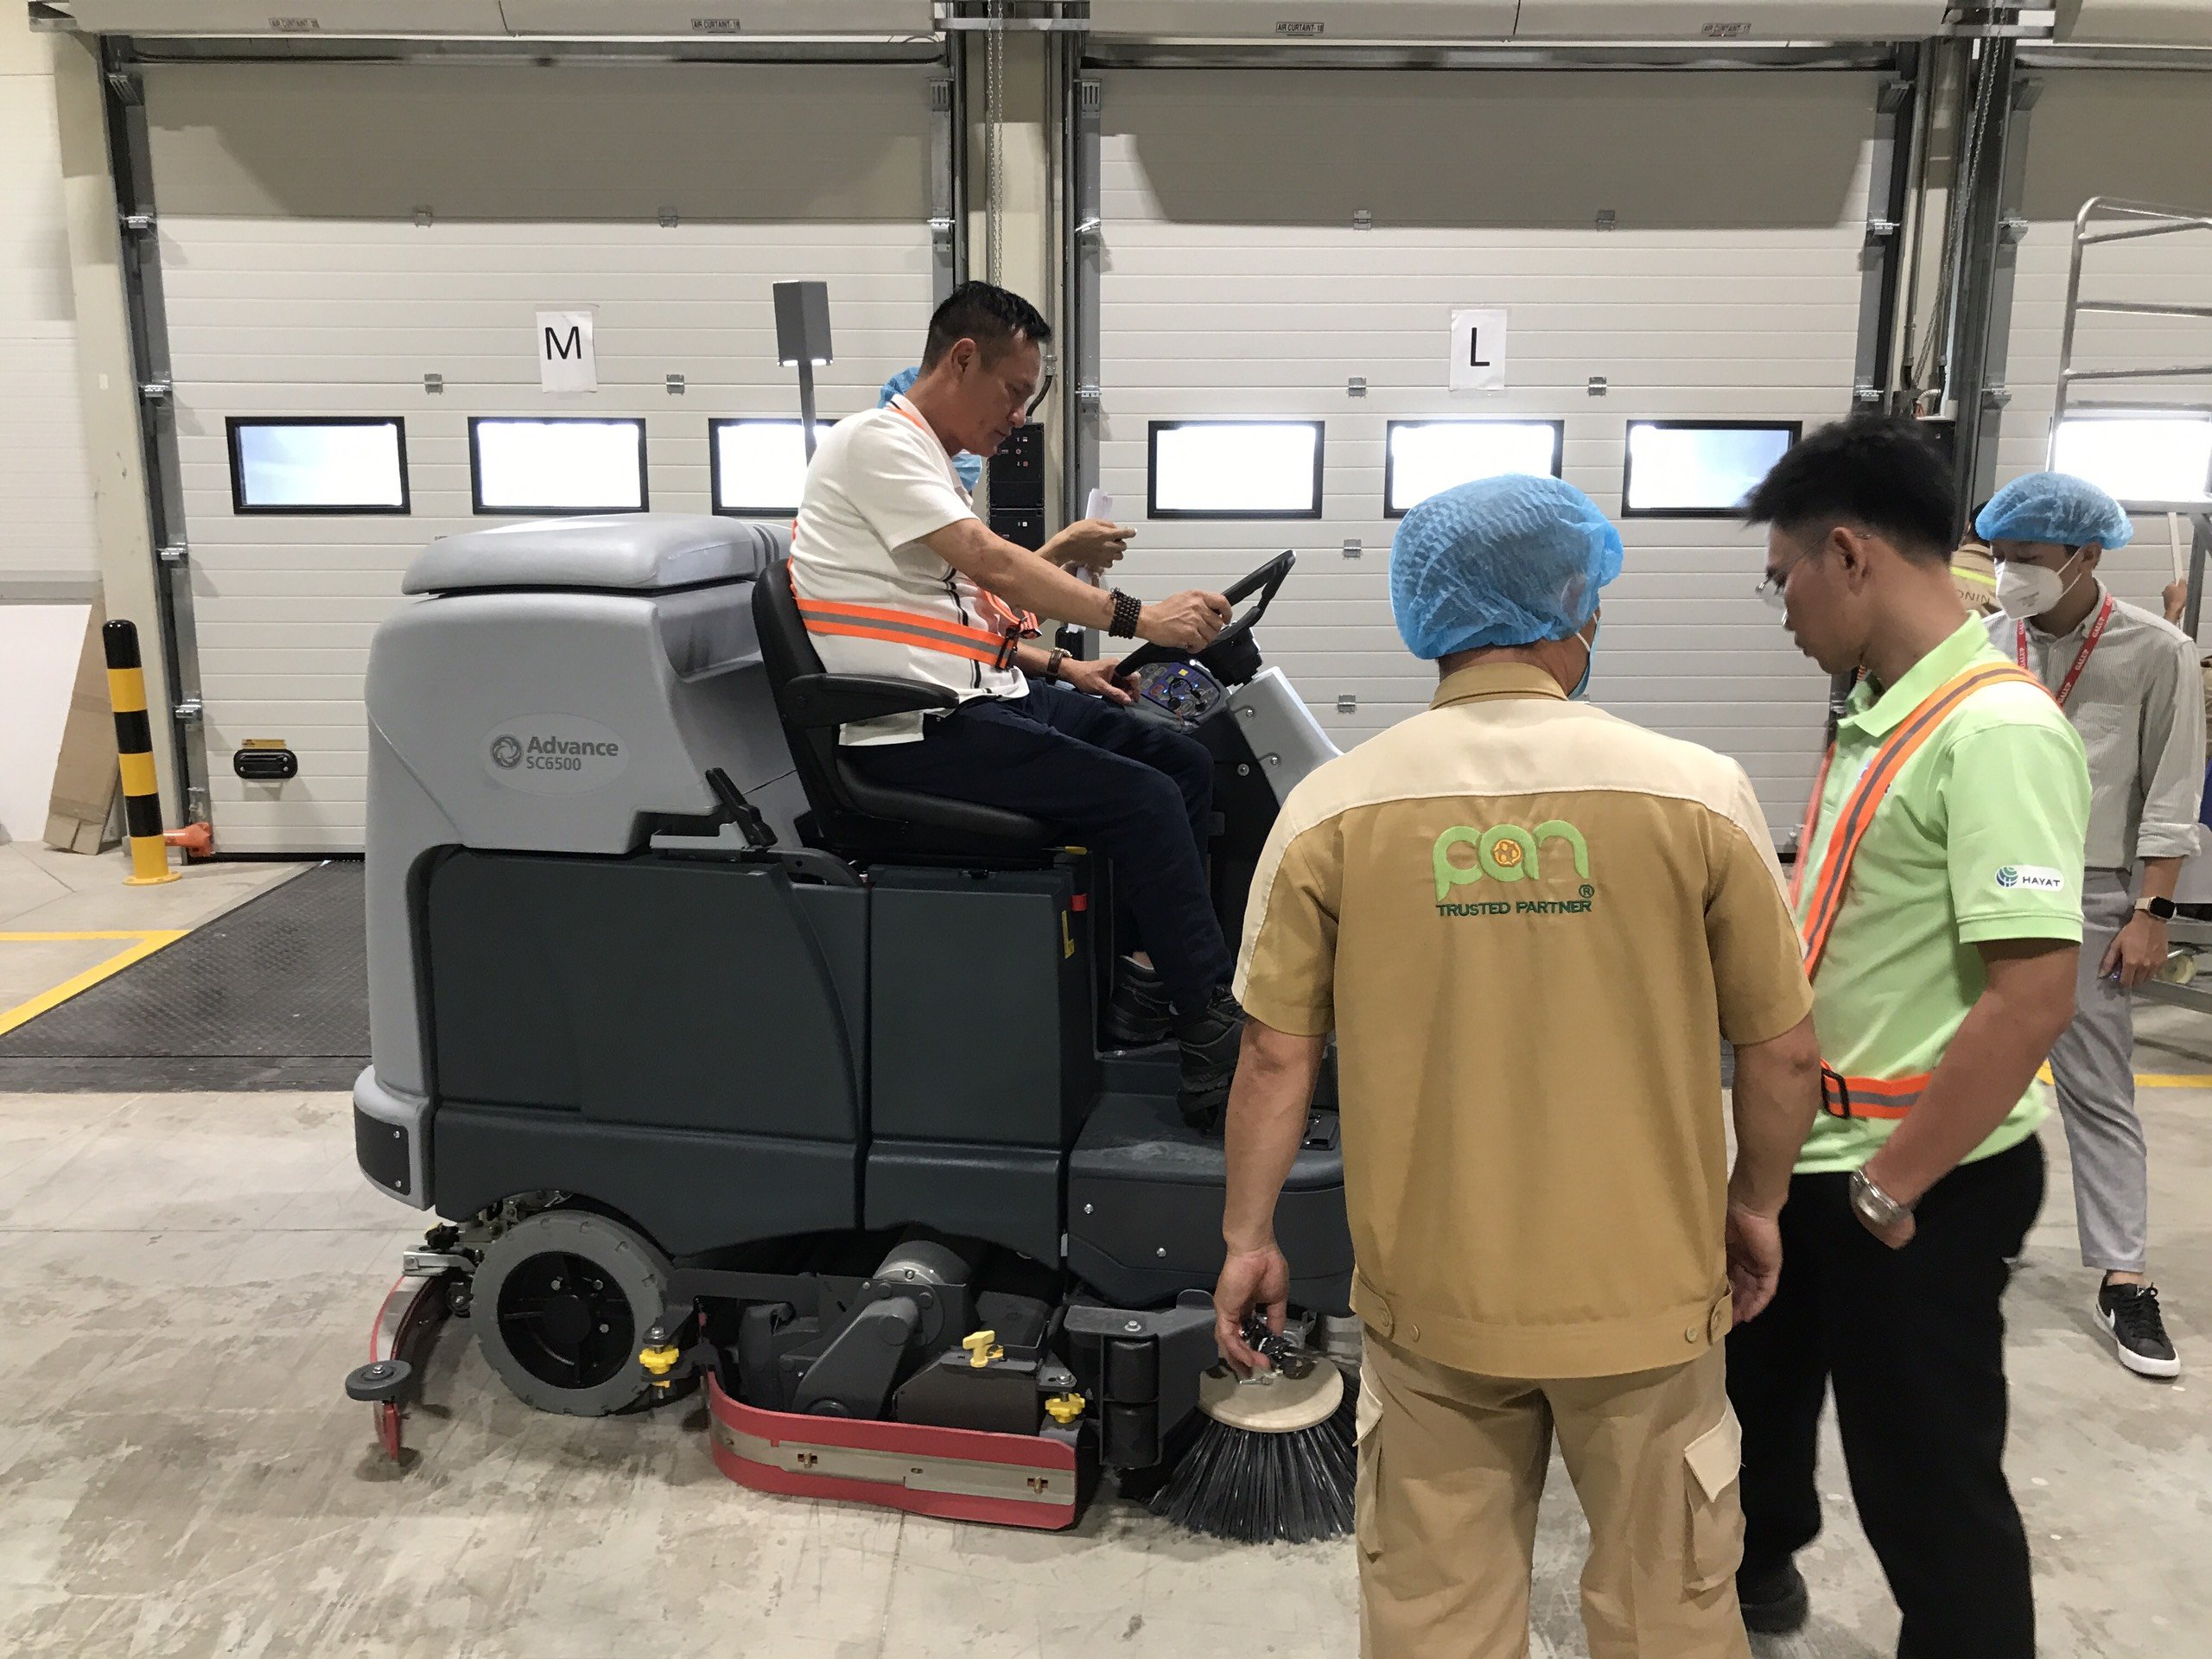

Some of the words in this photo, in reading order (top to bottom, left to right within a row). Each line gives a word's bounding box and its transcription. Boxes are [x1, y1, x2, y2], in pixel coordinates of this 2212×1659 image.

[545, 326, 582, 360] M
[1470, 327, 1491, 367] L
[526, 735, 619, 757] Advance
[525, 756, 582, 772] SC6500
[1433, 819, 1590, 902] pan
[2022, 876, 2061, 887] HAYAT
[1435, 901, 1511, 917] TRUSTED
[1516, 899, 1592, 914] PARTNER
